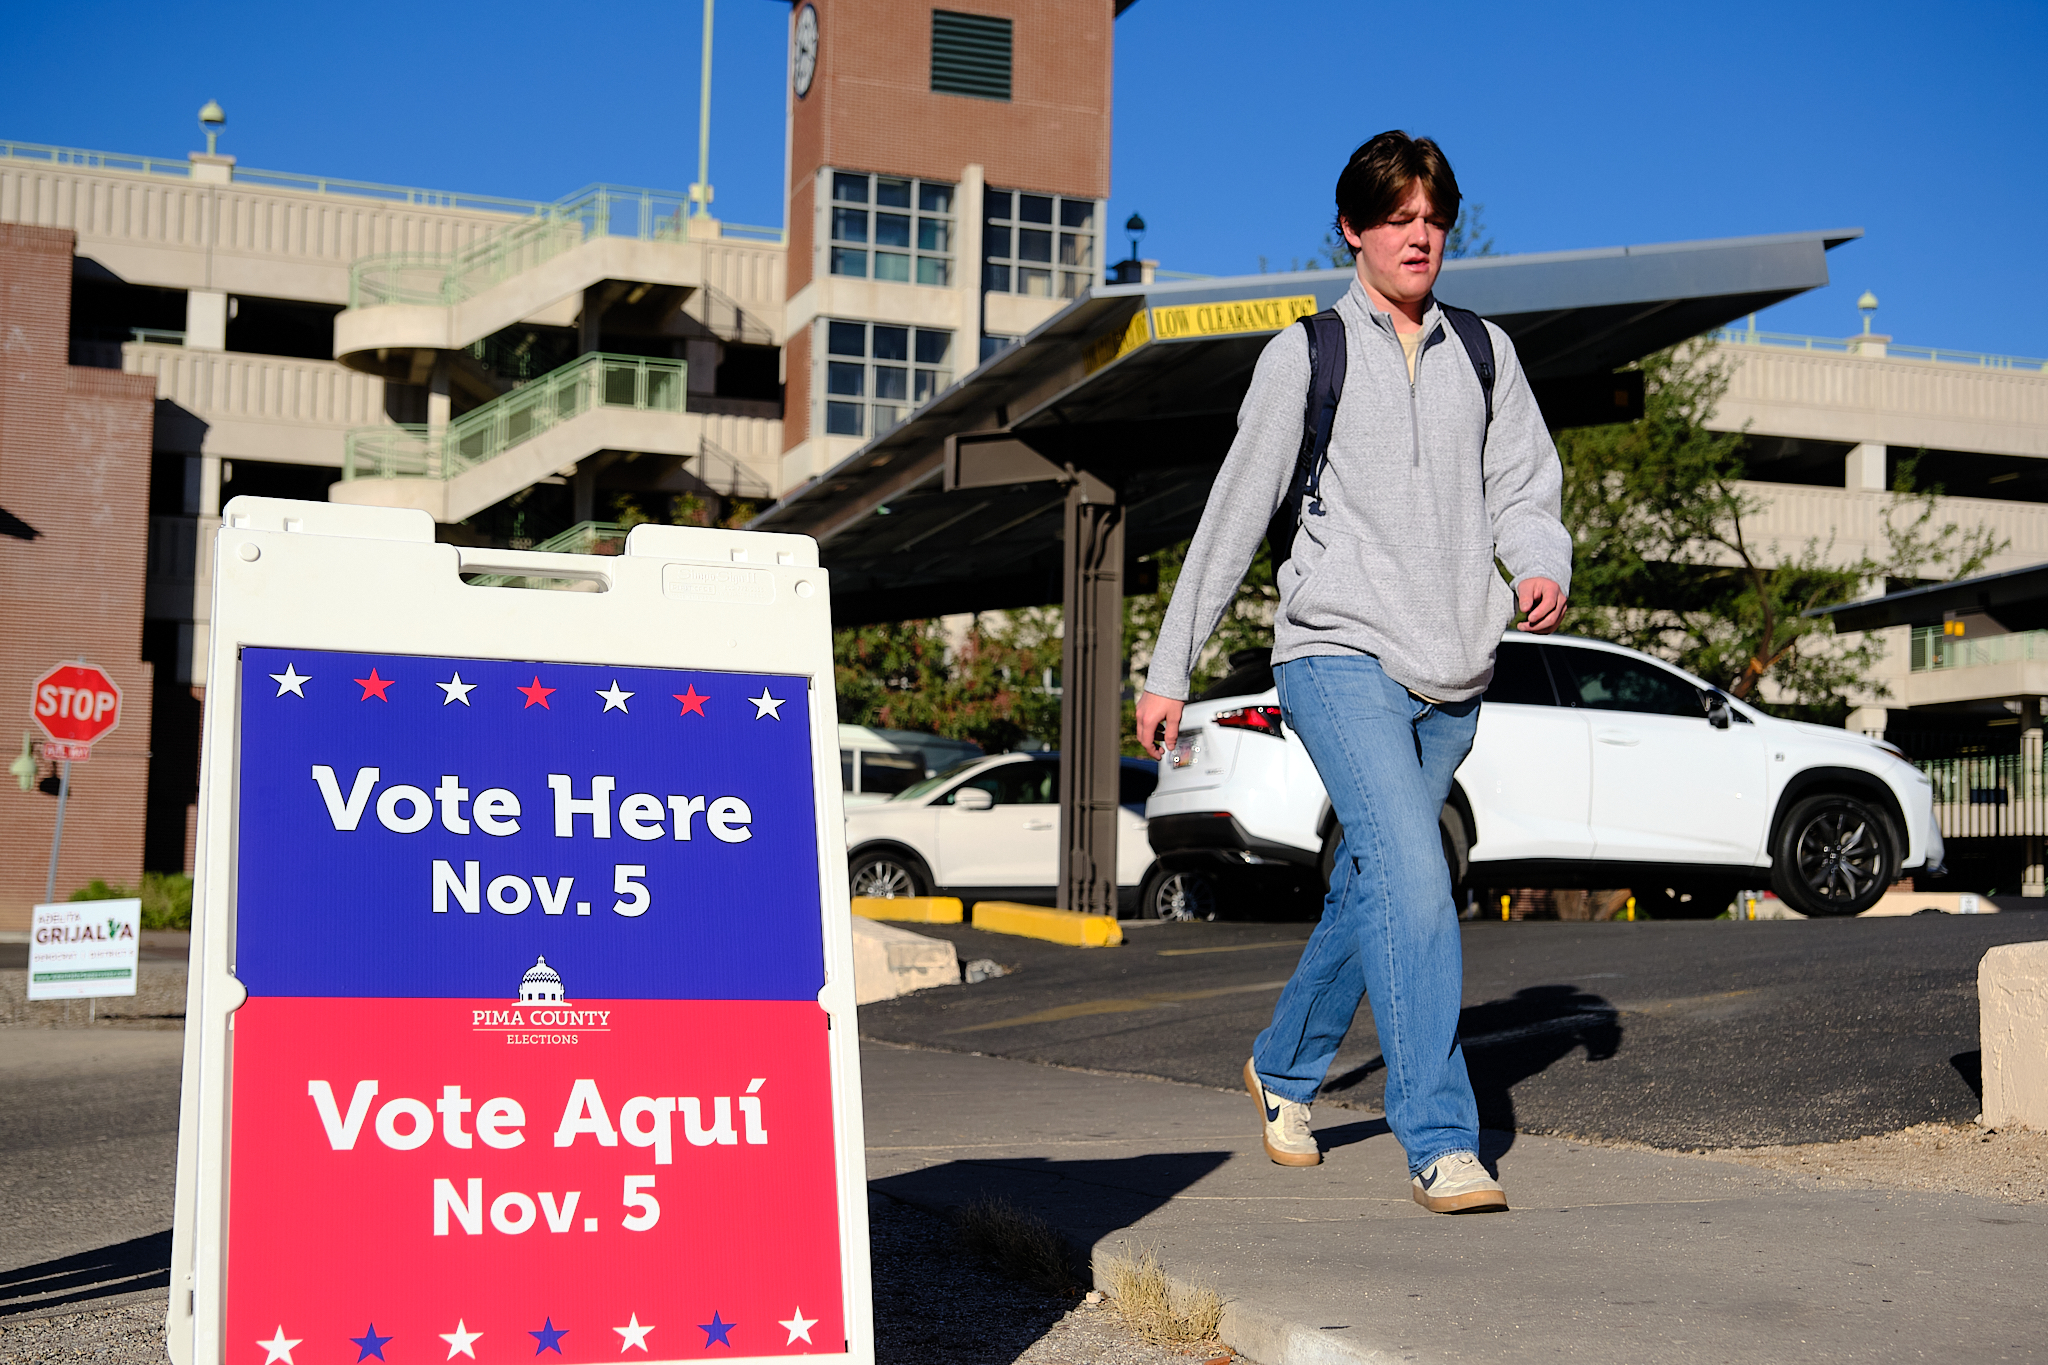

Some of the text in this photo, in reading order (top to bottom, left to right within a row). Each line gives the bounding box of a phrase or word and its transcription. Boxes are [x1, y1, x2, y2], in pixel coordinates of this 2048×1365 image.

[1155, 307, 1191, 337] LOW
[1196, 302, 1284, 333] CLEARANCE
[38, 685, 115, 721] STOP
[311, 764, 753, 844] Vote Here
[432, 859, 651, 918] Nov. 5
[472, 1010, 611, 1026] PIMA COUNTY
[507, 1034, 579, 1045] ELECTIONS
[308, 1078, 768, 1165] Vote Aquí
[432, 1174, 661, 1236] Nov. 5
